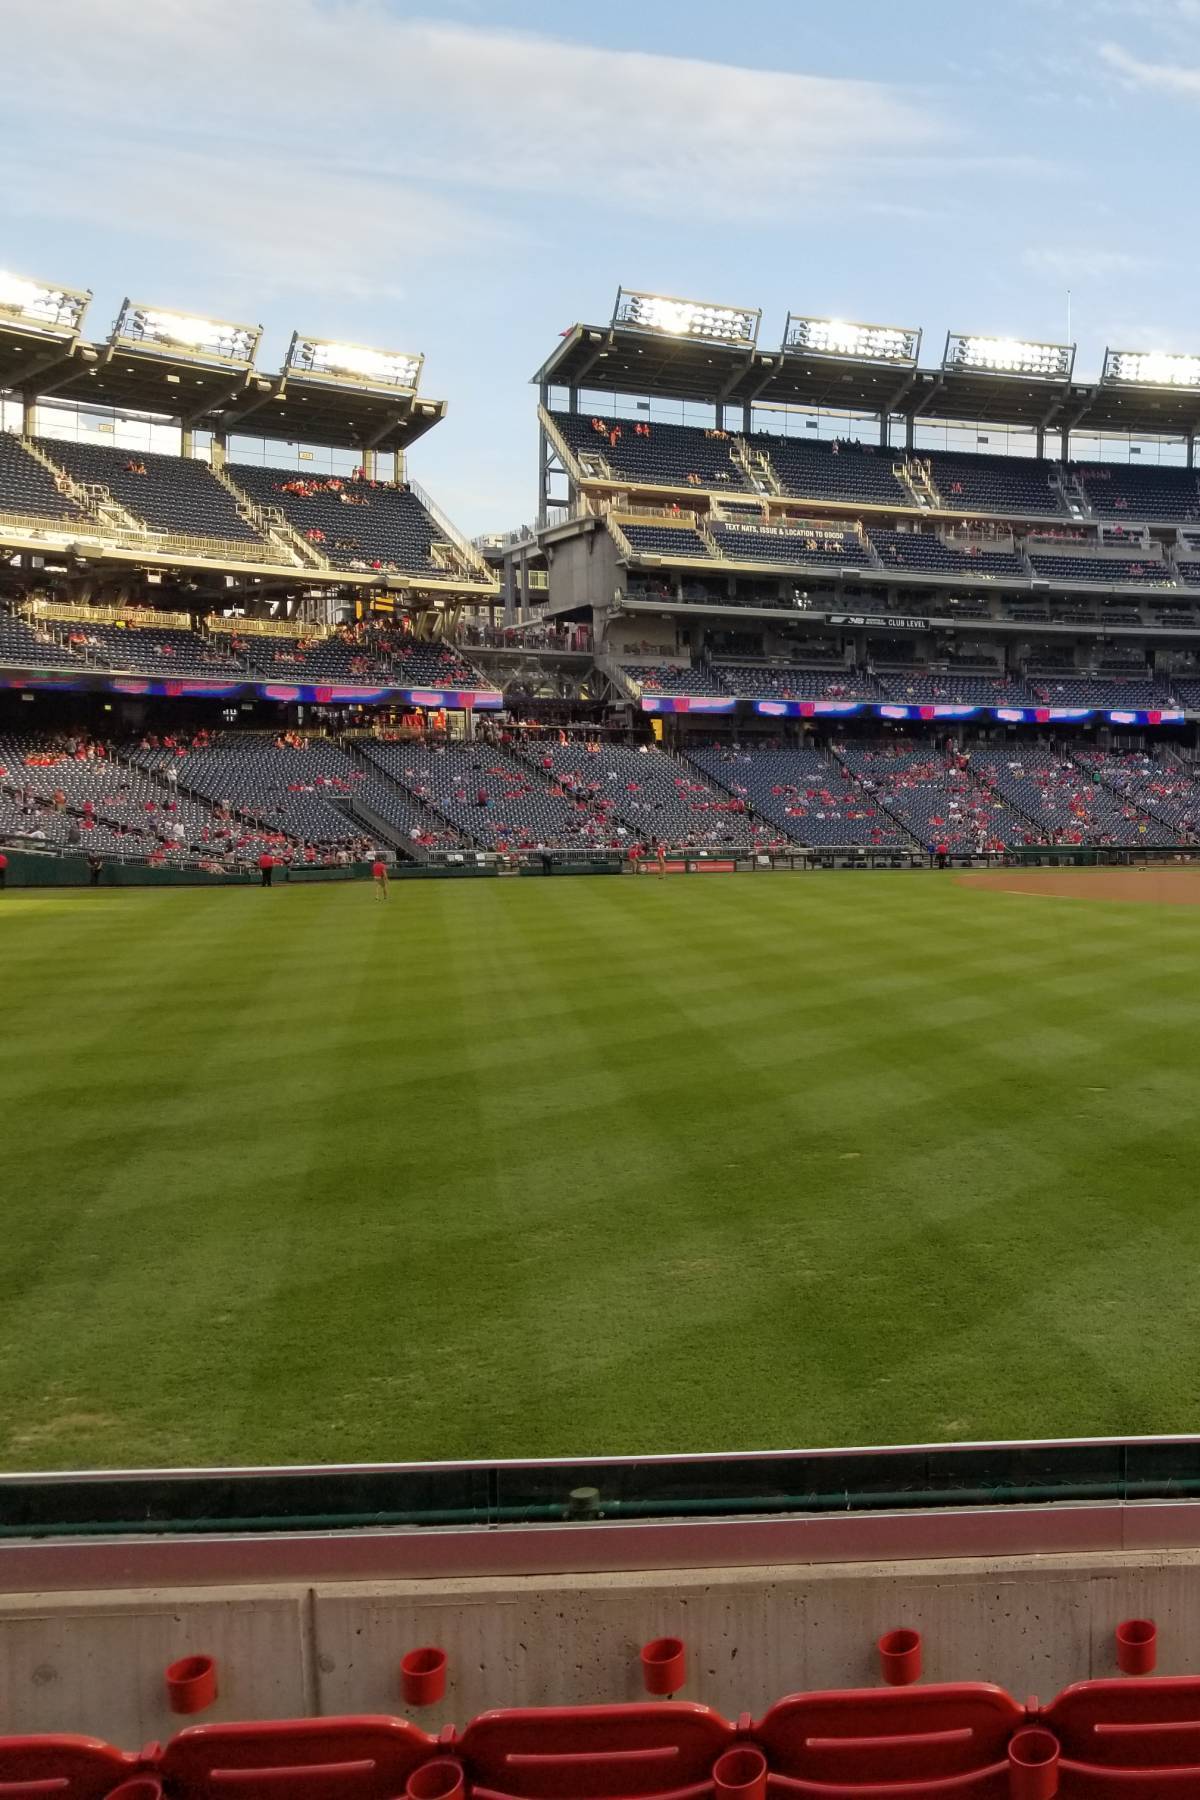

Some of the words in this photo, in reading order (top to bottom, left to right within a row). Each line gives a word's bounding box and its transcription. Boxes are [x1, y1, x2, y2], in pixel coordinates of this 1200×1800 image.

[725, 523, 740, 531] TEXT
[760, 527, 777, 535] ISSUE
[785, 529, 814, 537] LOCATION
[888, 619, 905, 627] CLUB
[906, 620, 925, 628] LEVEL
